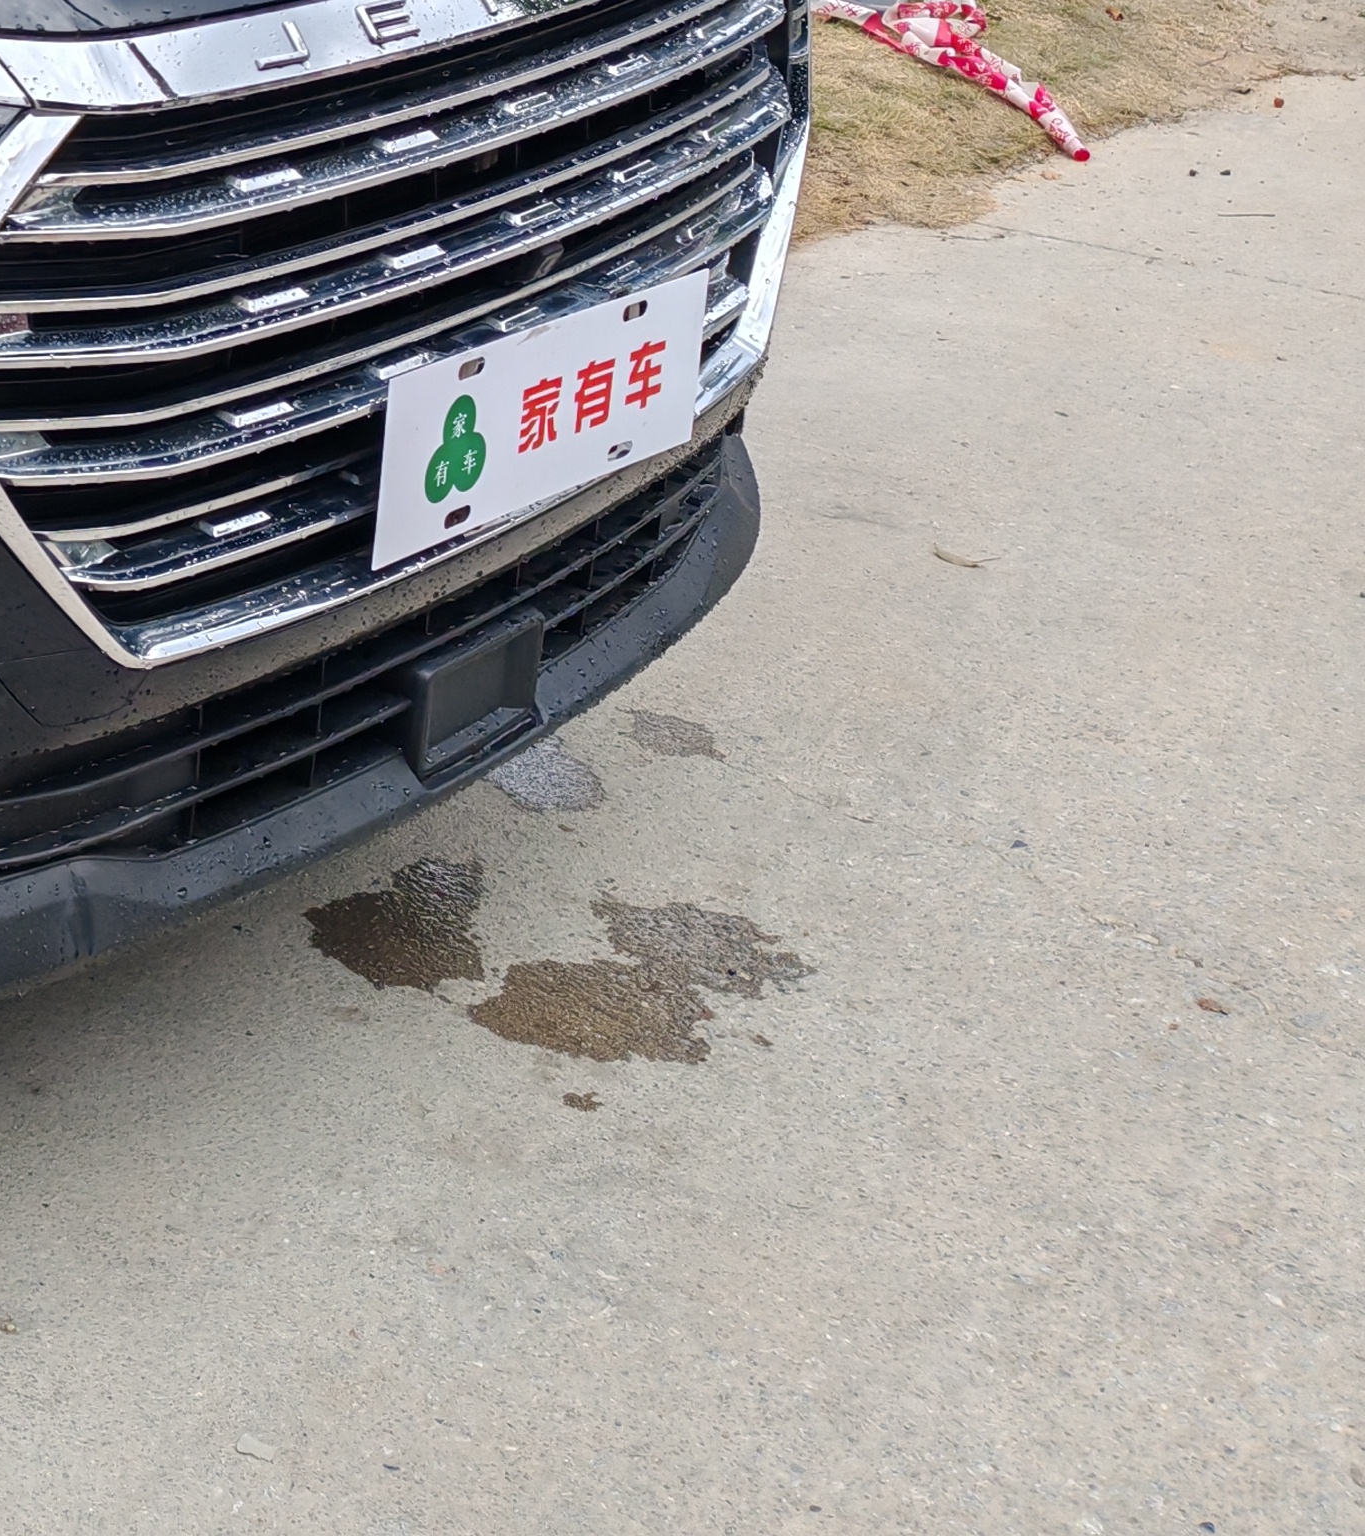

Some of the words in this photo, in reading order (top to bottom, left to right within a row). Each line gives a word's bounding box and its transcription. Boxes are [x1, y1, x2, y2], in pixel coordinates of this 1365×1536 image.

[450, 412, 468, 440] 家
[517, 339, 667, 455] 家有车
